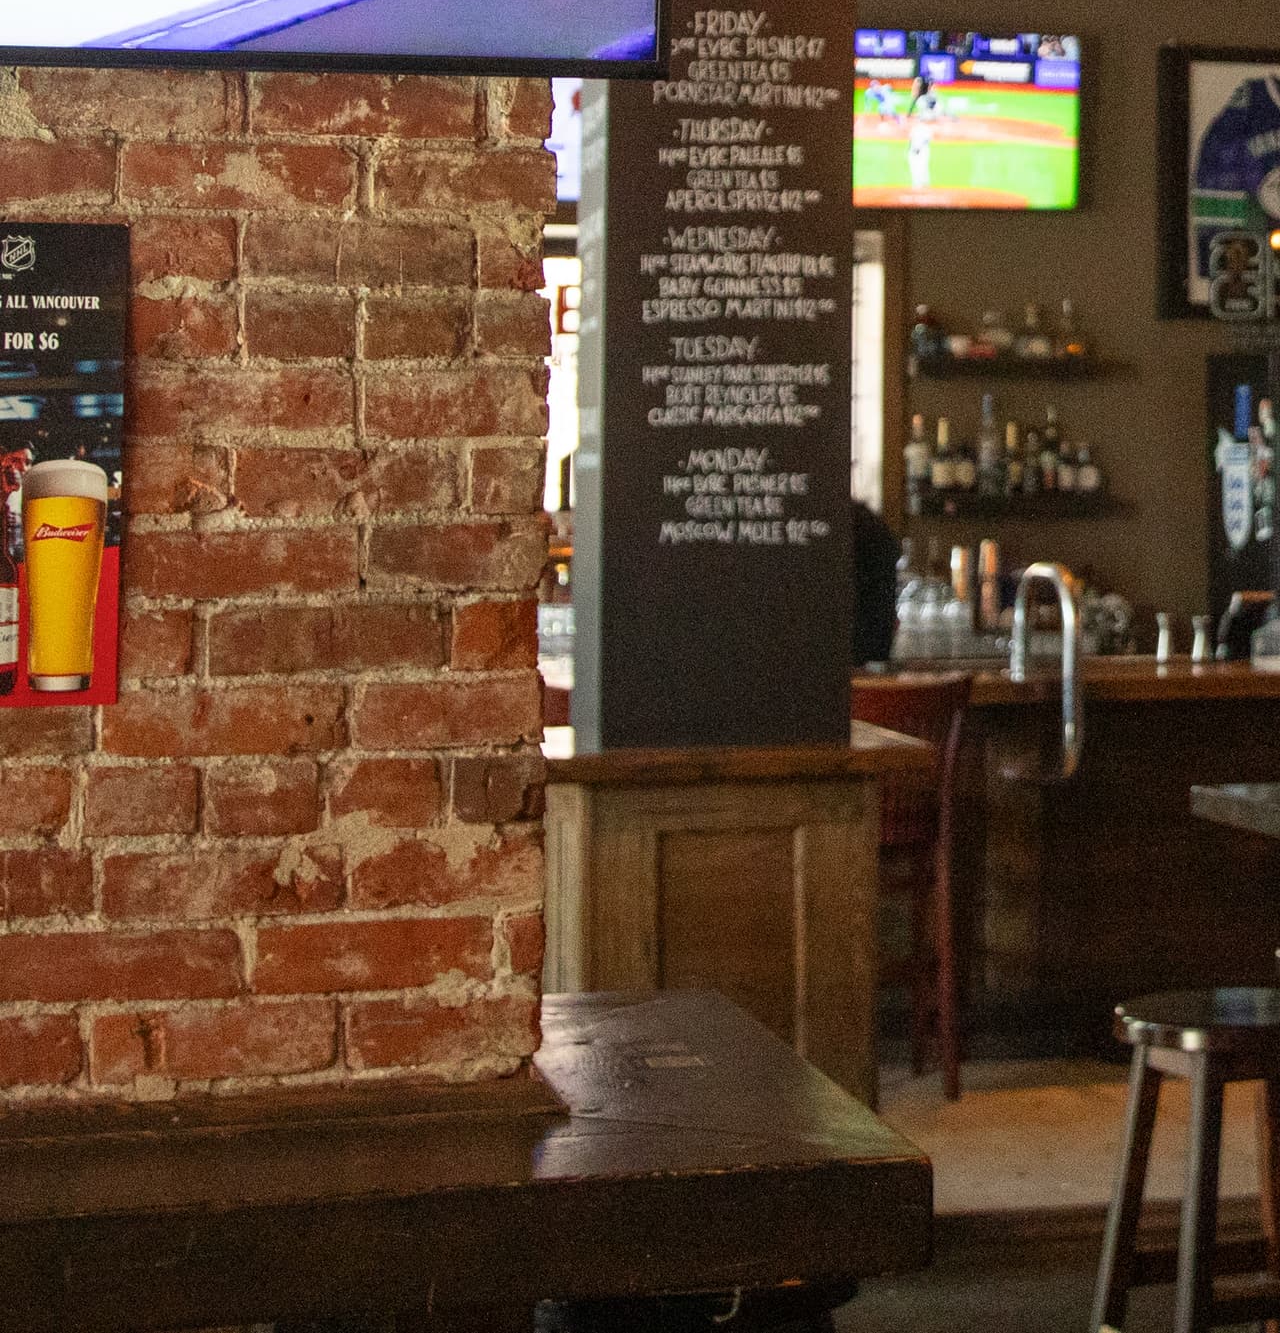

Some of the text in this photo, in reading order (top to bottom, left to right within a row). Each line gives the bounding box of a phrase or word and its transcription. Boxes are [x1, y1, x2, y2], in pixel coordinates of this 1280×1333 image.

[694, 9, 767, 36] FRIDAY
[667, 225, 777, 253] WEDNESDAY
[9, 244, 29, 261] NHL
[6, 295, 100, 309] ALL VANCOUVER
[4, 330, 60, 351] FOR $6
[670, 335, 760, 361] TUESDAY
[686, 447, 769, 474] MONDAY
[36, 526, 89, 538] Budweiser
[658, 520, 735, 545] MOSCOW
